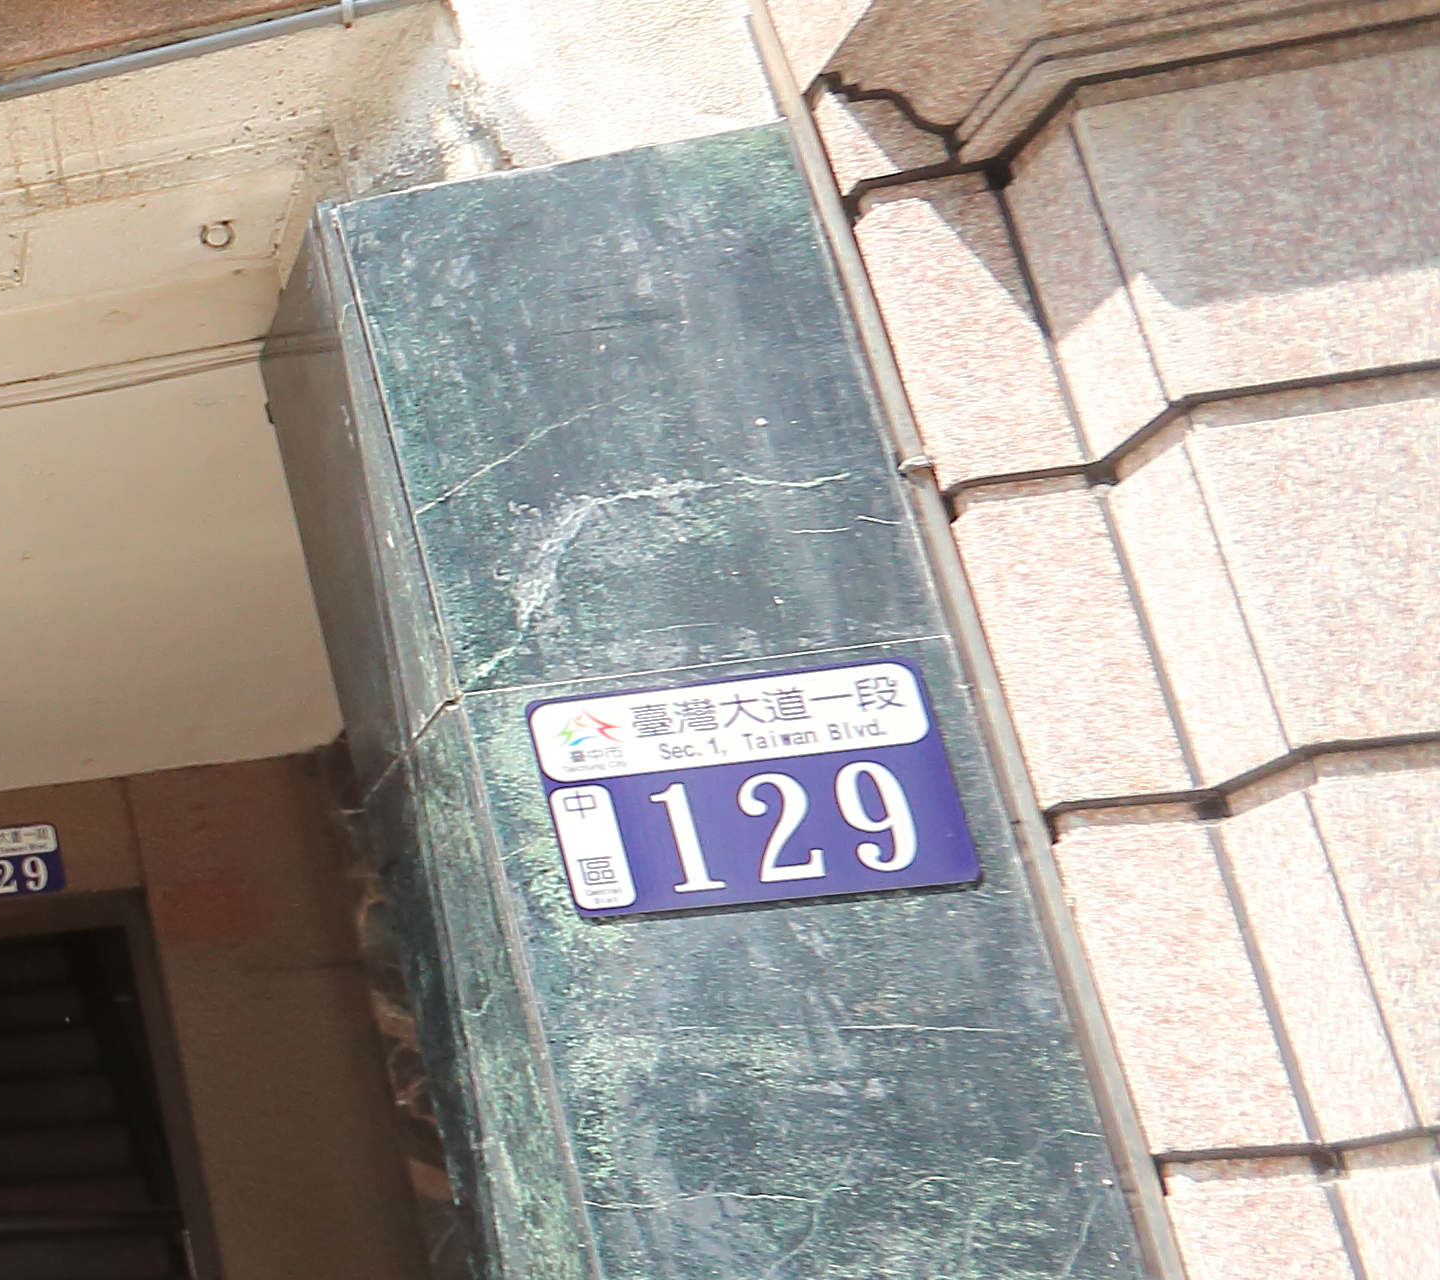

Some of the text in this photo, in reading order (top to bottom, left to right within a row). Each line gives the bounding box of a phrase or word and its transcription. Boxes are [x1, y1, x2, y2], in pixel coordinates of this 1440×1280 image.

[629, 676, 907, 739] 臺灣大道一段
[744, 729, 818, 752] Taiwan
[829, 719, 888, 743] Blvd.
[649, 761, 918, 892] 129
